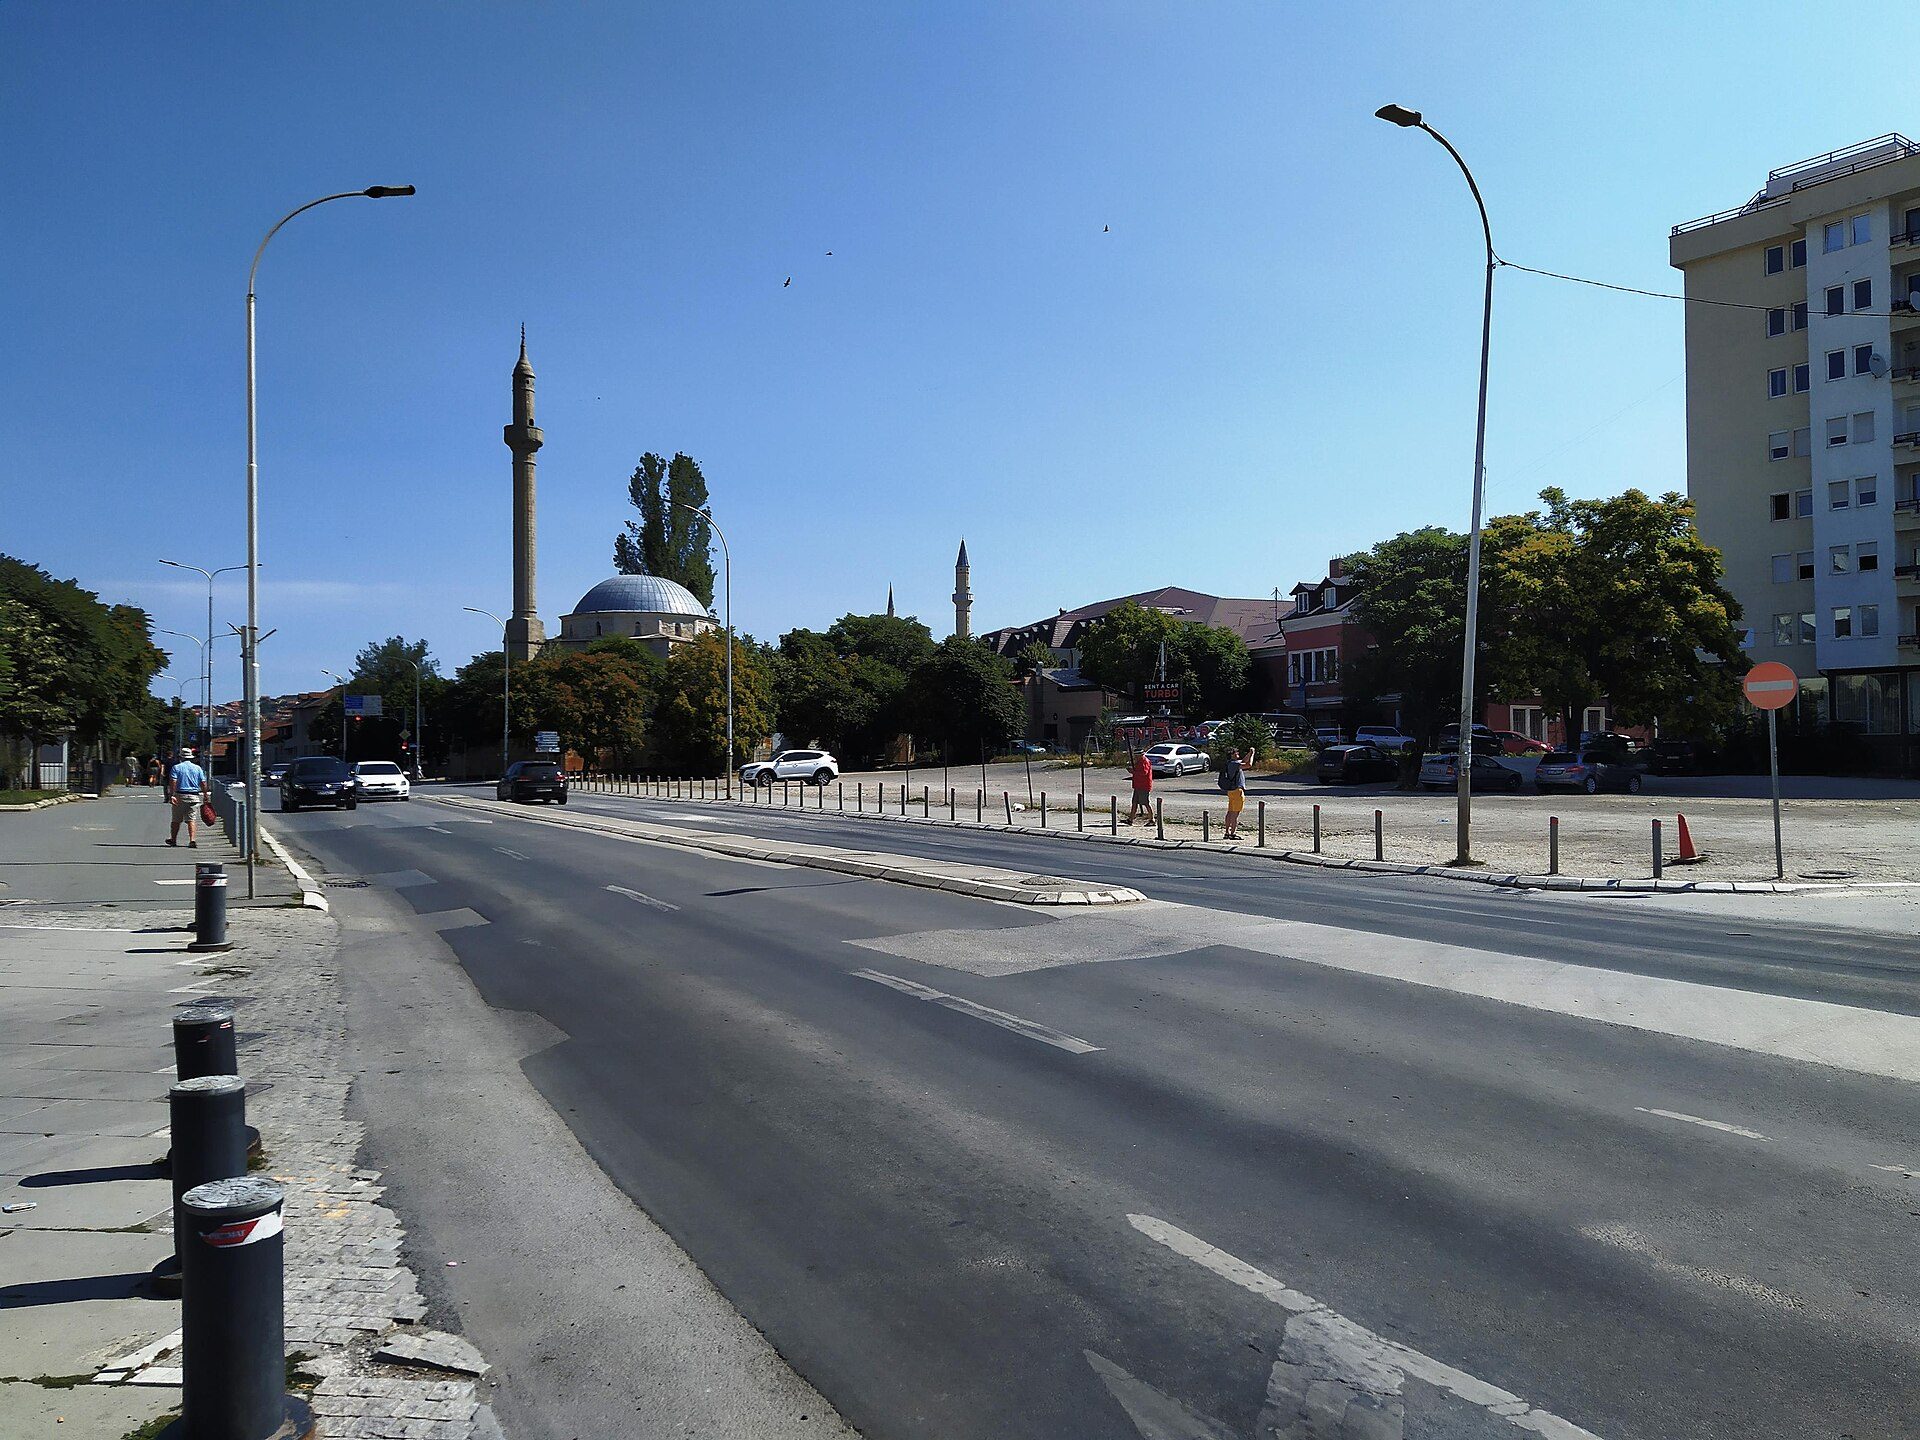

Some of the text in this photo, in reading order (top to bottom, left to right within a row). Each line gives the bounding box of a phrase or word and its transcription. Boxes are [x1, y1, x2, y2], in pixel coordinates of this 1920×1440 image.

[1144, 689, 1179, 698] TURBO
[1115, 725, 1210, 740] RENT A CAR
